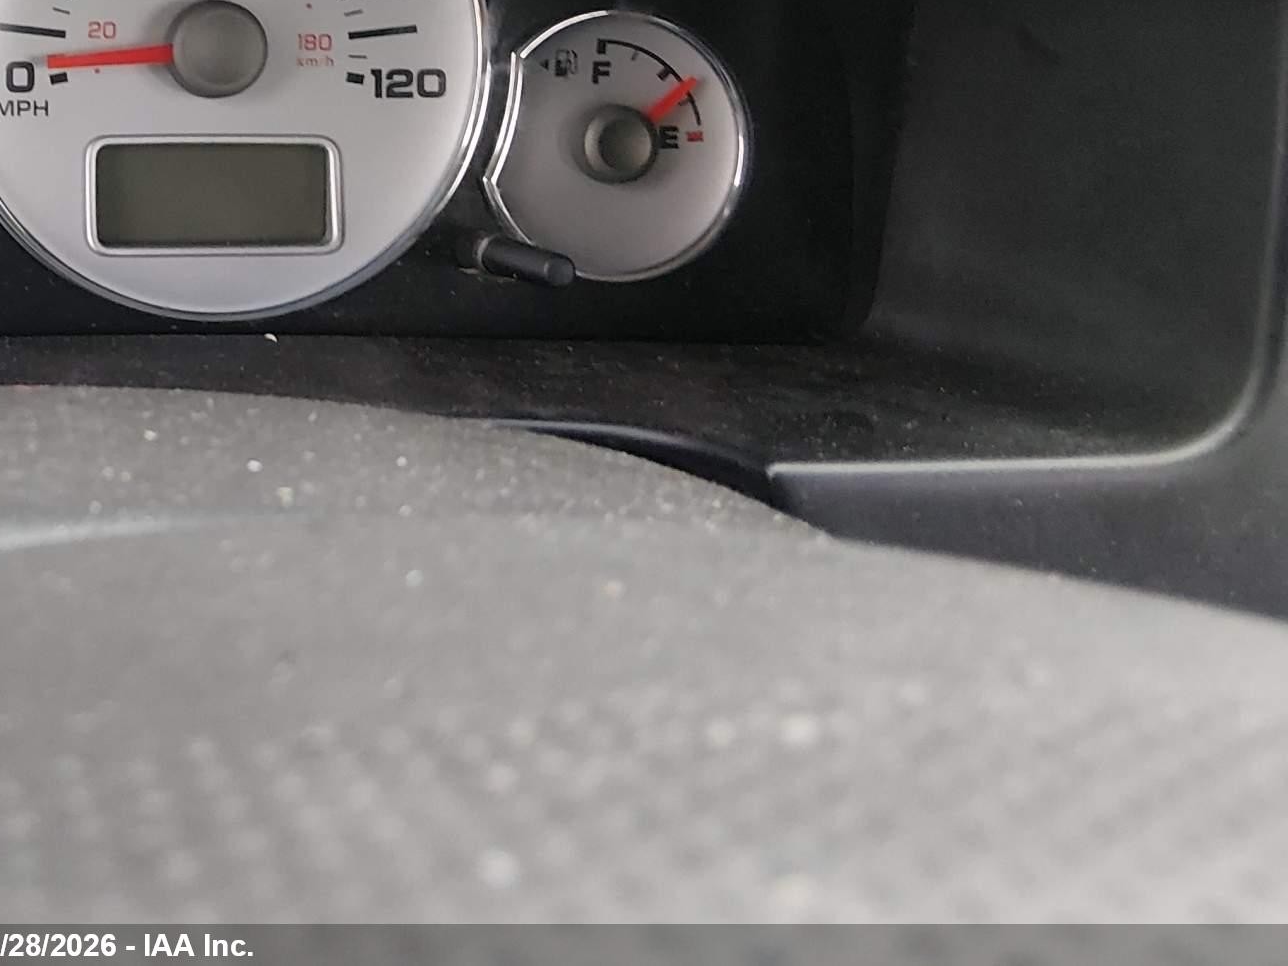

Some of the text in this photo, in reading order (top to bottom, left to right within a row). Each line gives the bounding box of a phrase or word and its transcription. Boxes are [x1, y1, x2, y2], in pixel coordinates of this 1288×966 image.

[88, 22, 116, 39] 20
[298, 34, 332, 51] 180
[6, 61, 35, 93] 0
[371, 69, 446, 98] 120
[592, 61, 611, 84] F
[659, 125, 679, 150] E
